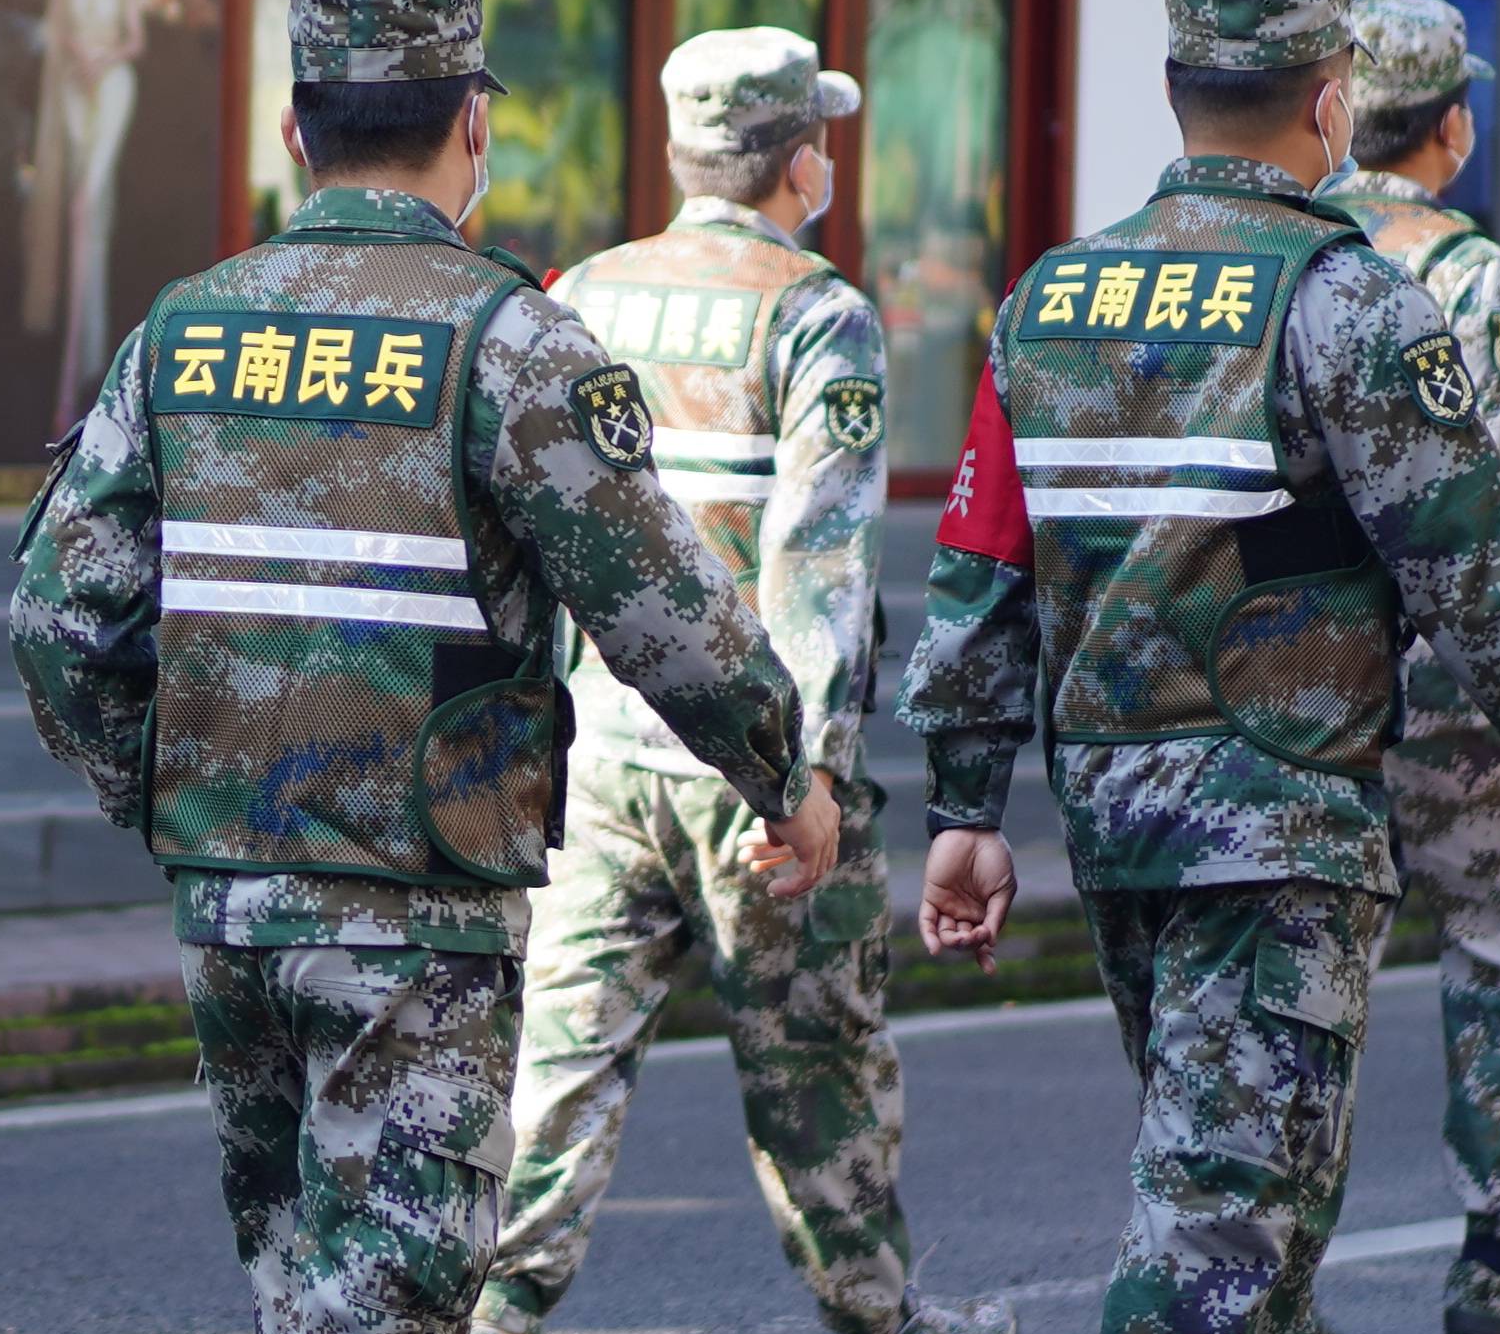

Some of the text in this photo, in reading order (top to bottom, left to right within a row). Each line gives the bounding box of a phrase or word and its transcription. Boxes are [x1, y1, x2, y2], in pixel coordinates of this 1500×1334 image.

[1037, 260, 1256, 334] 云南民兵
[172, 324, 426, 413] 云南民兵
